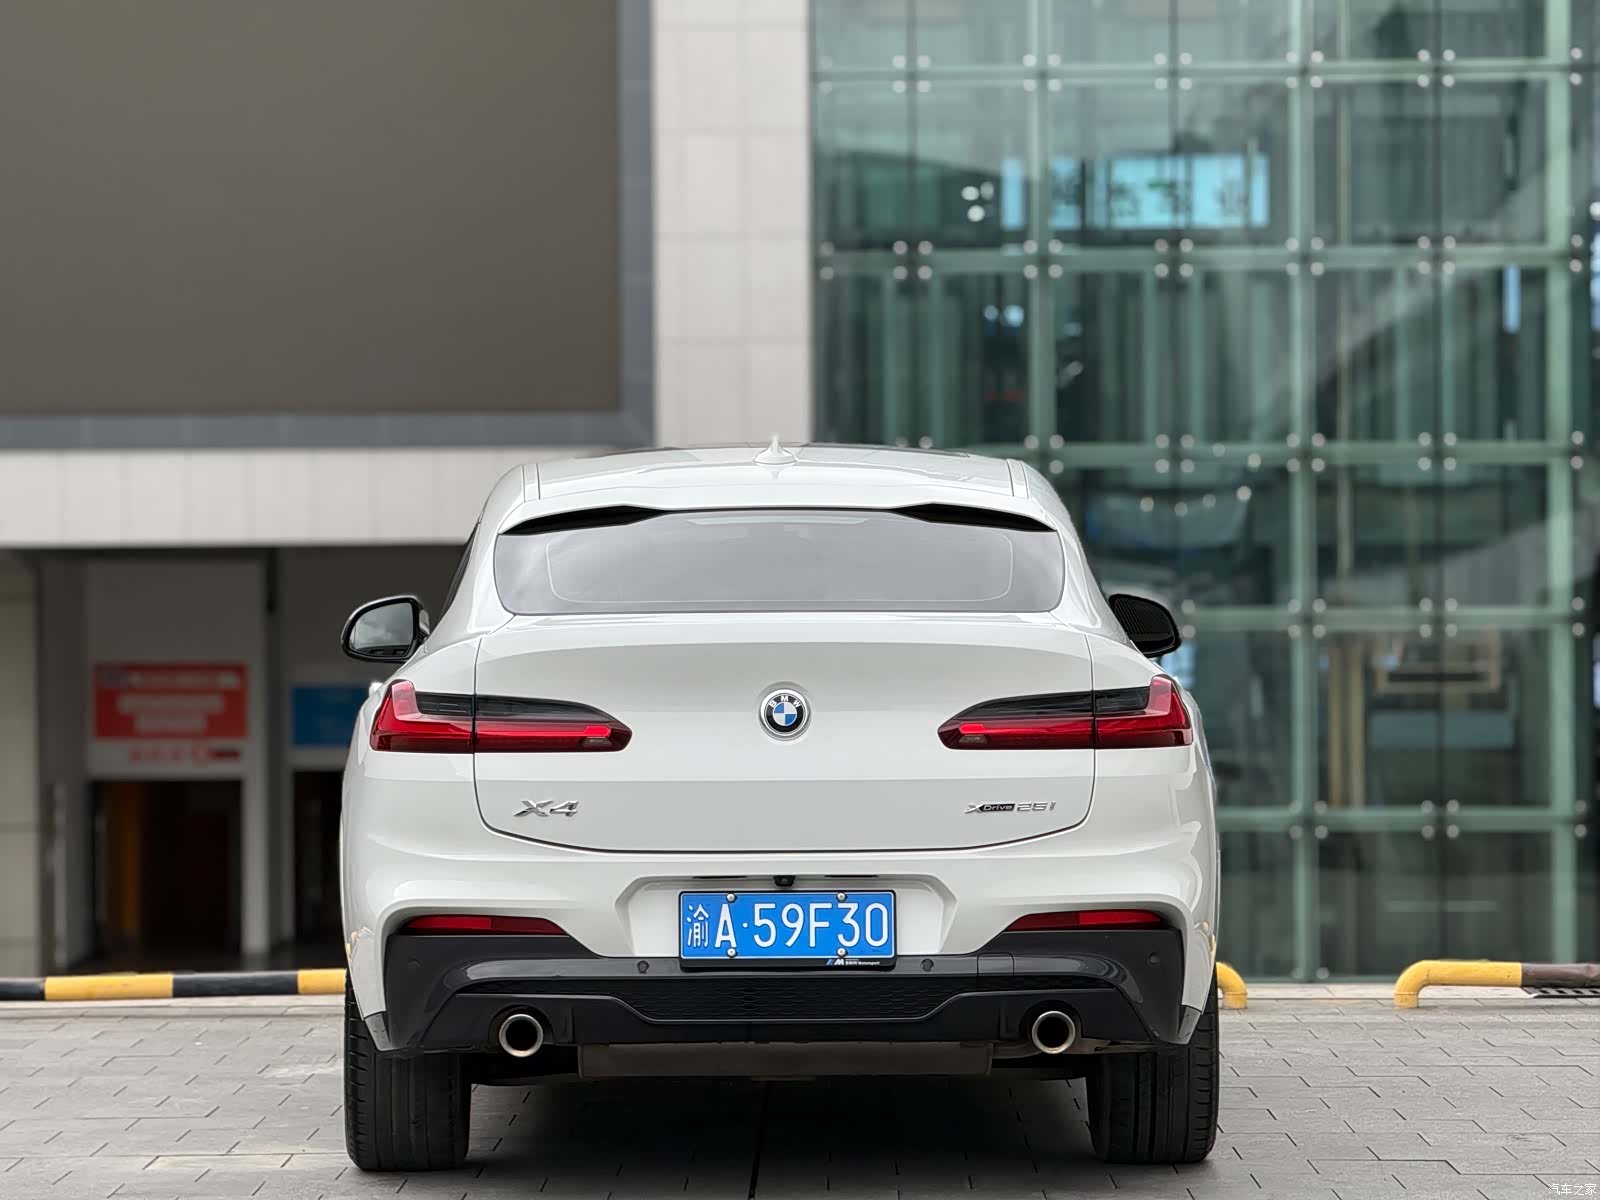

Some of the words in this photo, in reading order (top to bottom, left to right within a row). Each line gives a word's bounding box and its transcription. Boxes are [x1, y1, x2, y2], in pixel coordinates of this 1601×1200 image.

[768, 694, 801, 708] BMW
[513, 800, 580, 817] X4
[687, 903, 889, 948] 渝A·59F30
